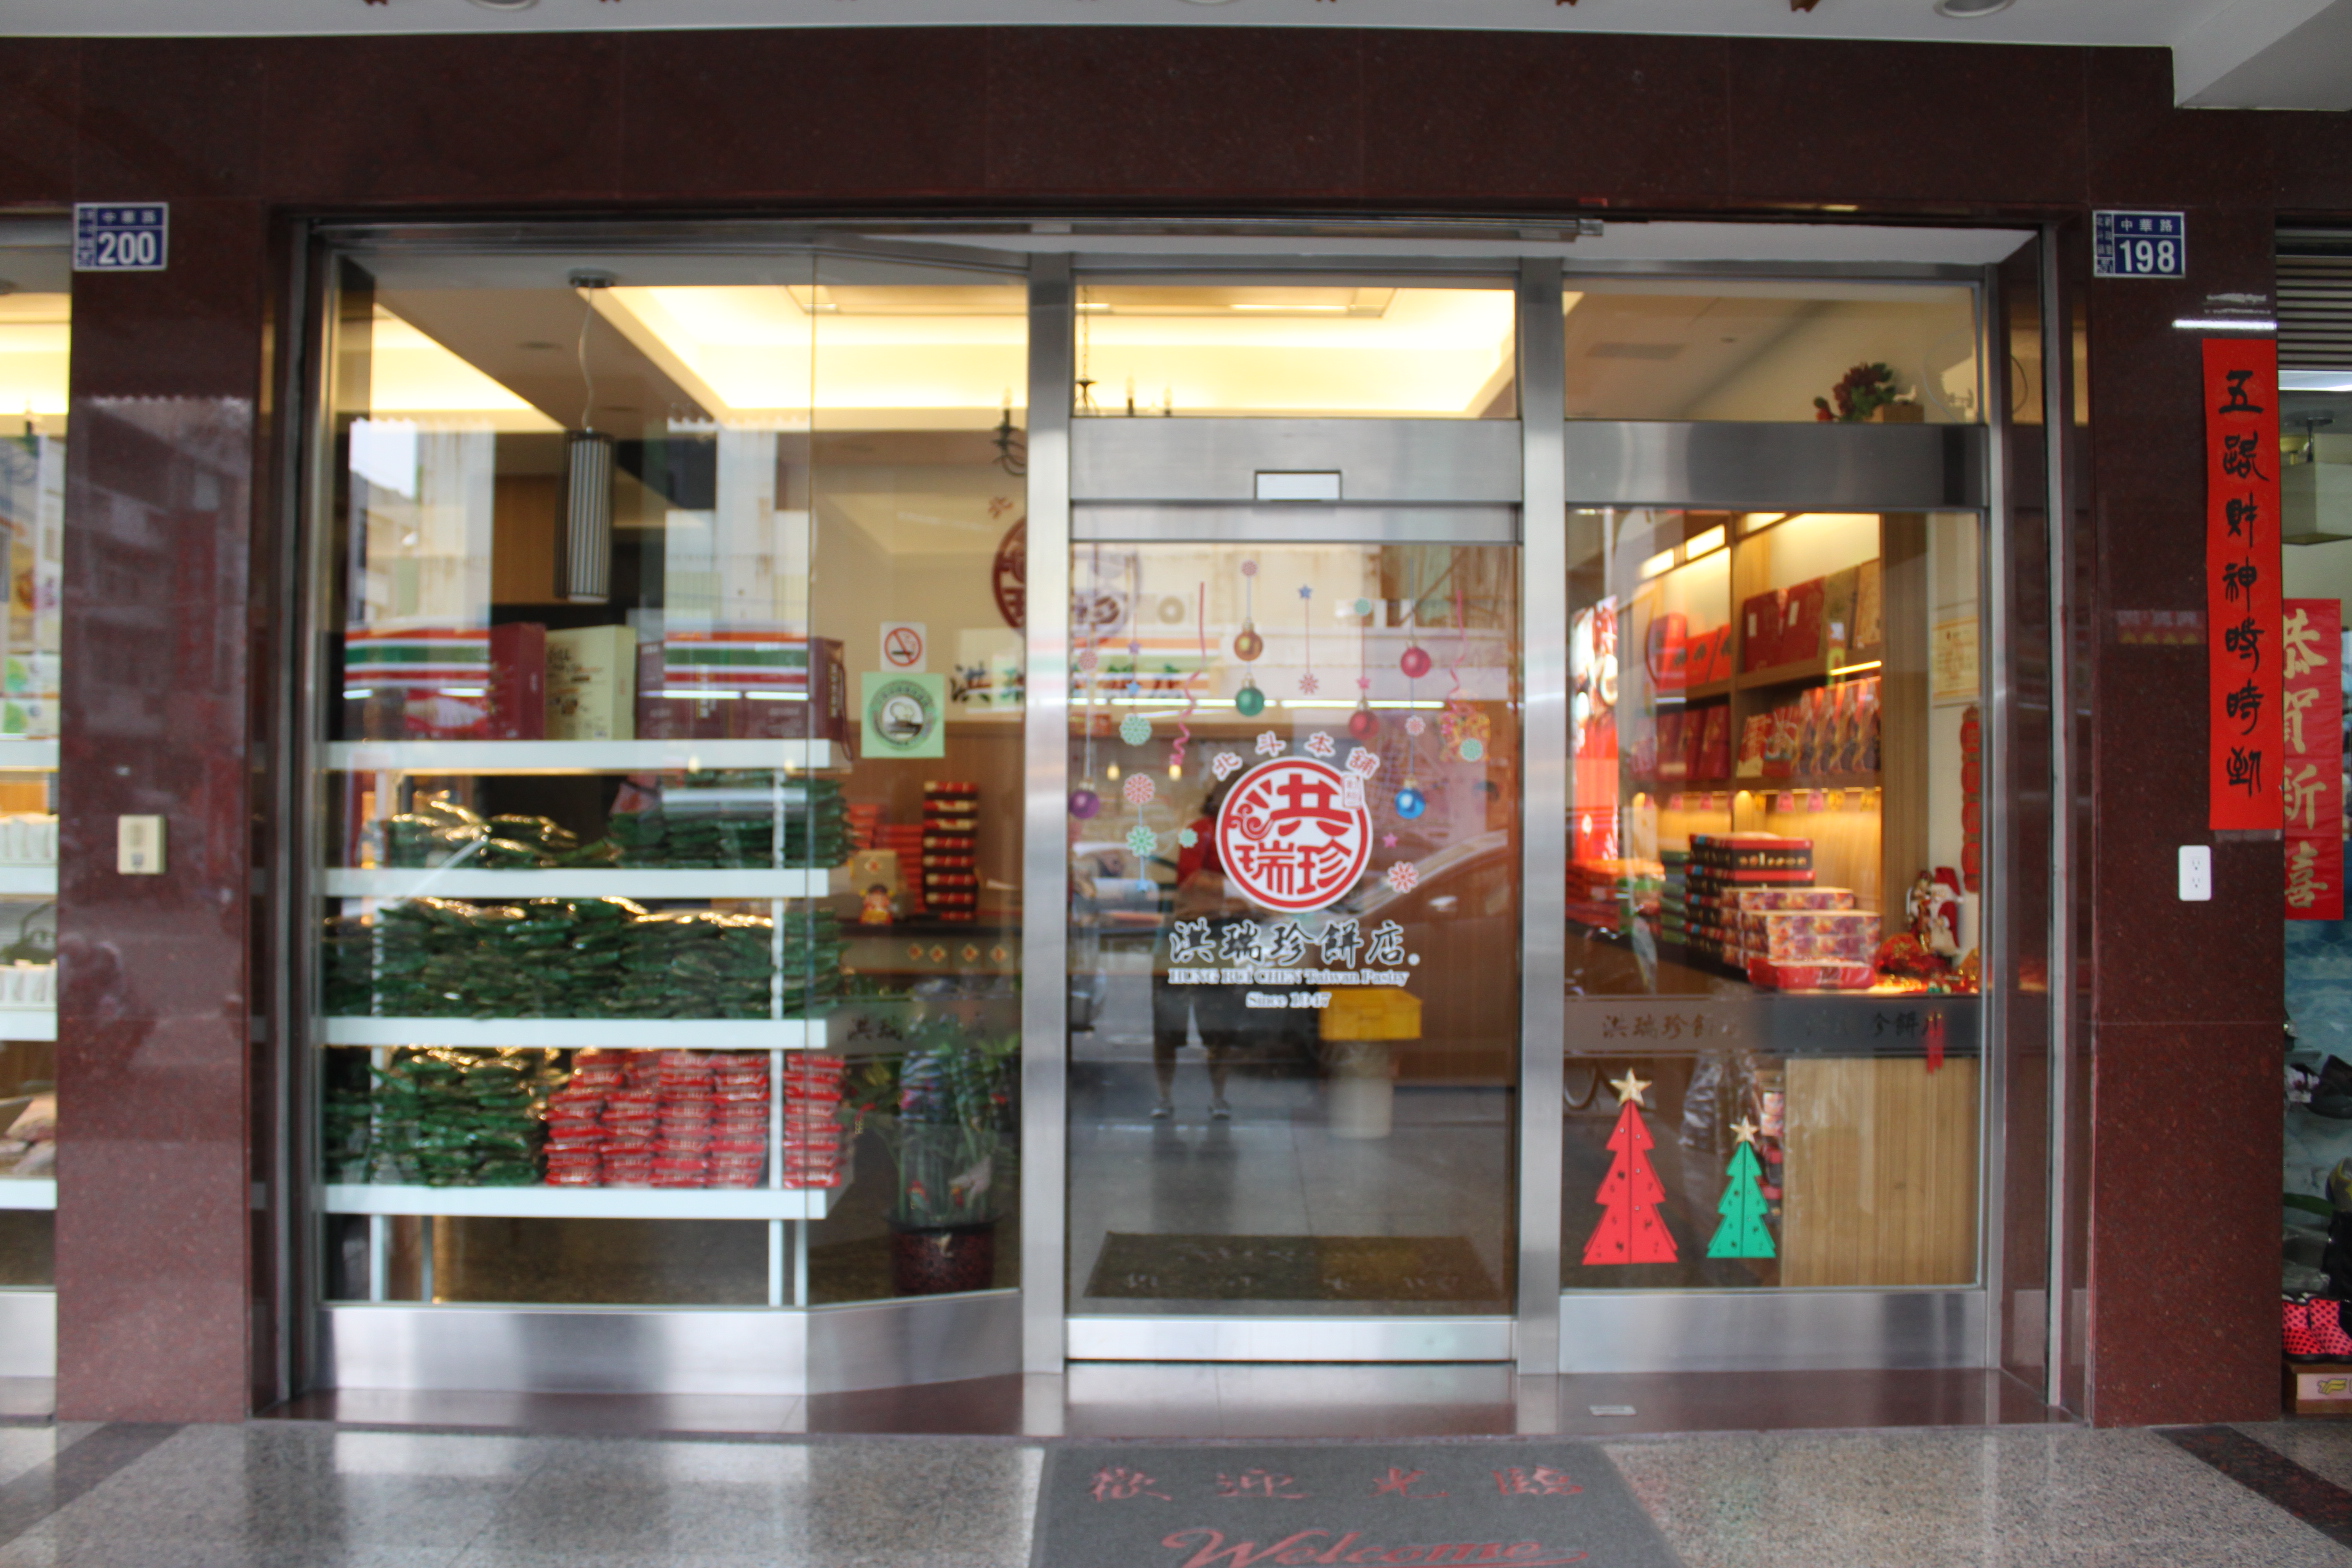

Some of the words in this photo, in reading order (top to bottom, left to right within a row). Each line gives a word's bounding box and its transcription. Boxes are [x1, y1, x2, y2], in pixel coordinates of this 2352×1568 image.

[2120, 217, 2173, 233] 中華路
[98, 231, 156, 265] 200
[2119, 239, 2175, 273] 198
[1169, 917, 1404, 968] 洪瑞珍餅店
[1168, 968, 1219, 985] HUNG
[1254, 968, 1302, 985] CHEN
[1304, 968, 1359, 985] Taiwan
[1361, 968, 1409, 987] Pastry
[1246, 992, 1288, 1008] Since
[1091, 1466, 1584, 1500] 歡迎光臨
[1161, 1528, 1589, 1568] Welcome
